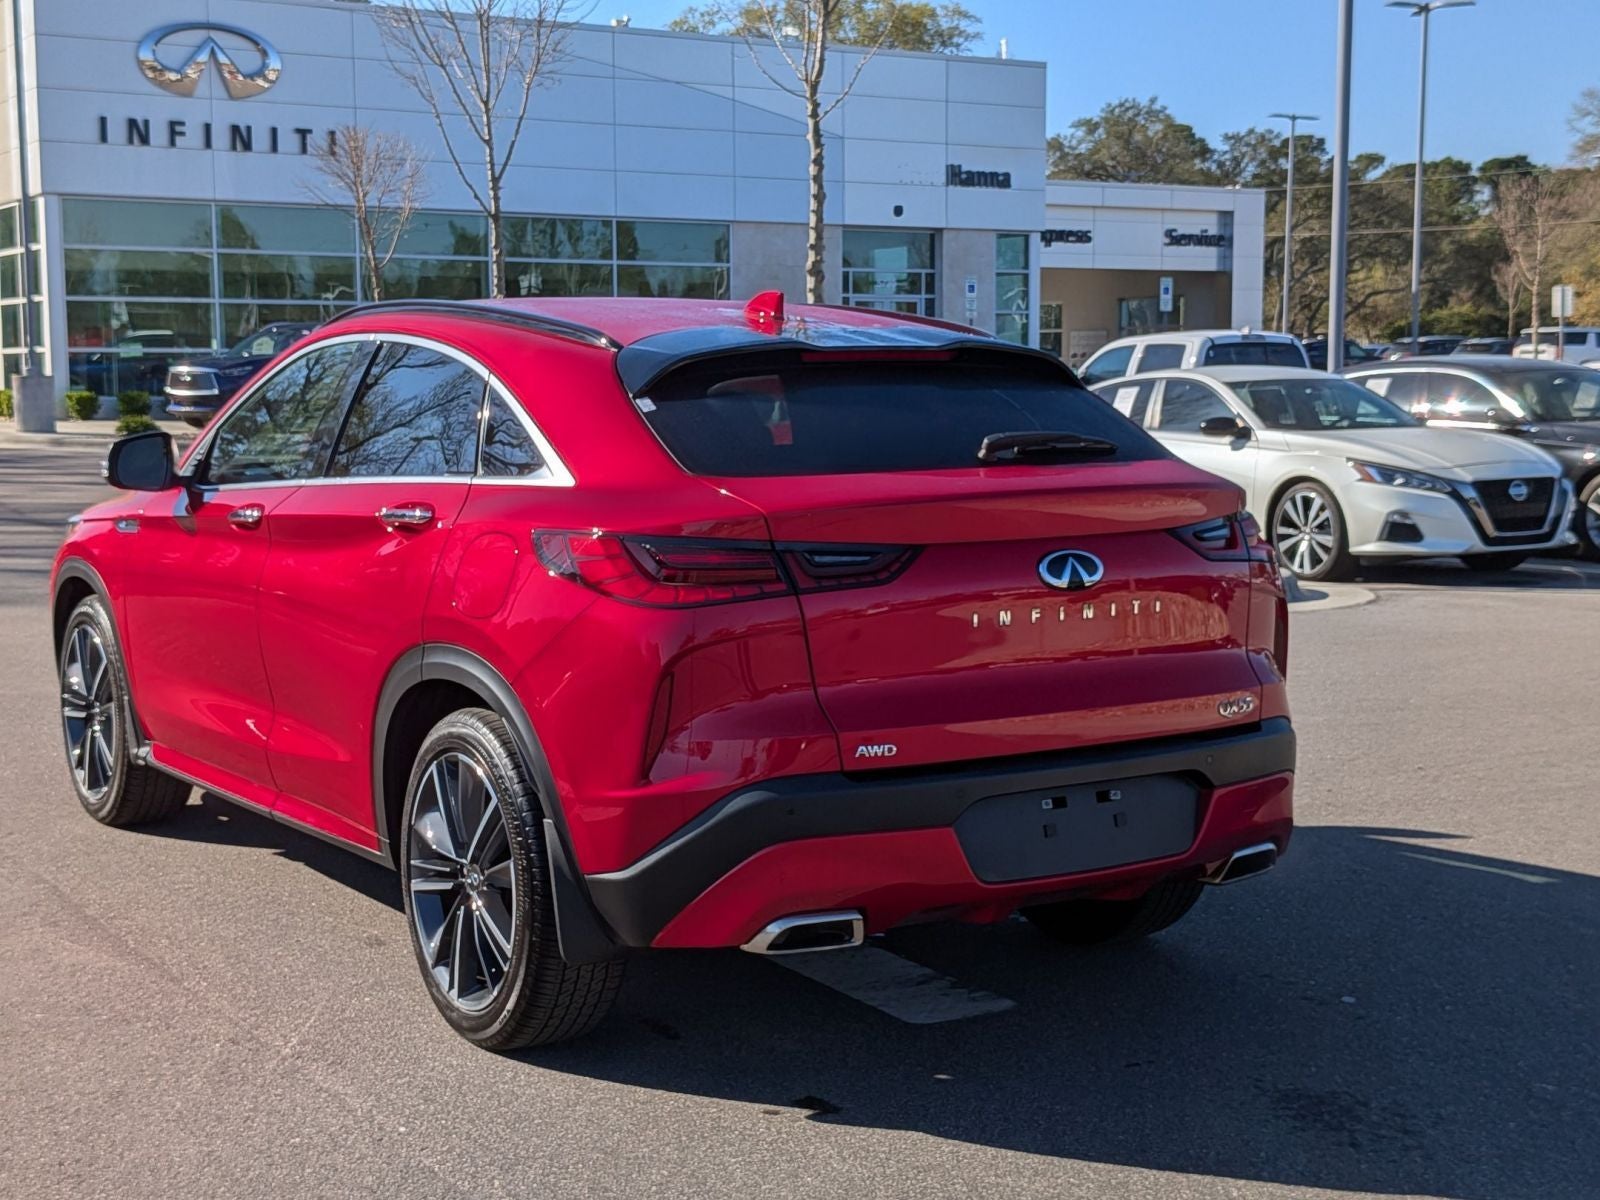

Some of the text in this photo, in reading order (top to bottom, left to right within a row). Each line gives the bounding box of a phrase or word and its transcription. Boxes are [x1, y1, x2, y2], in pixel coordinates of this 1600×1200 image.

[98, 116, 337, 155] INFINITI
[946, 164, 1012, 189] Hanna
[1163, 228, 1226, 248] Service
[972, 600, 1161, 628] INFINITI
[854, 743, 898, 759] AWD
